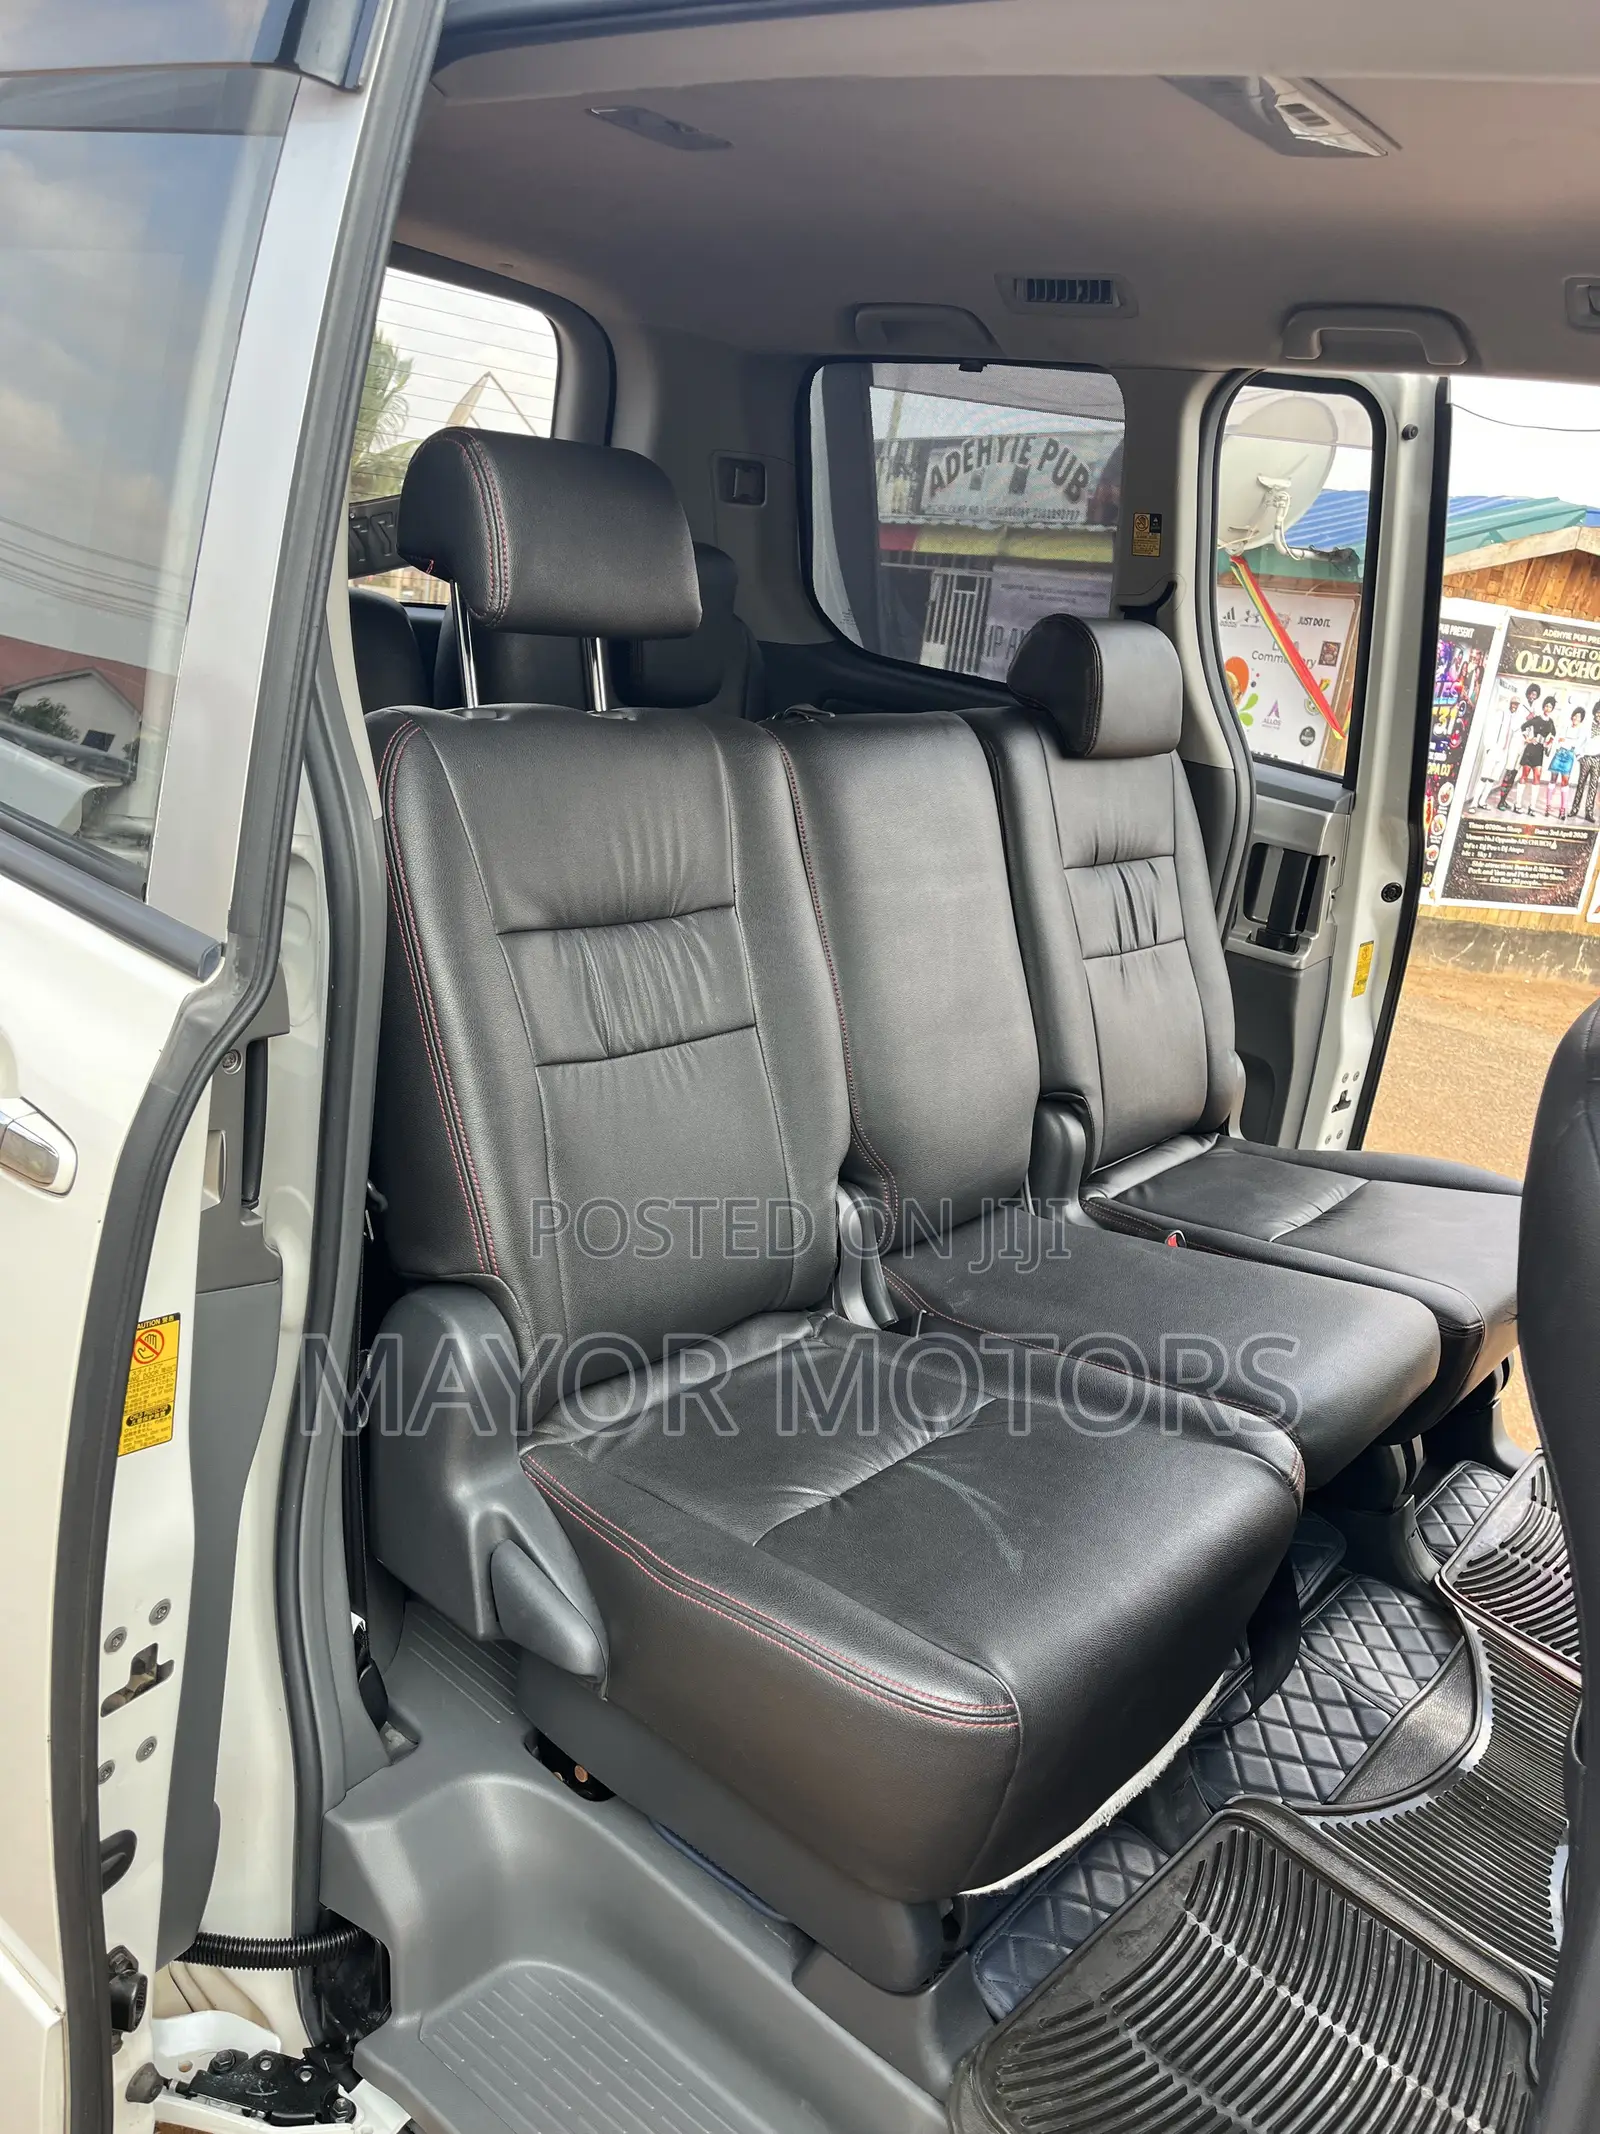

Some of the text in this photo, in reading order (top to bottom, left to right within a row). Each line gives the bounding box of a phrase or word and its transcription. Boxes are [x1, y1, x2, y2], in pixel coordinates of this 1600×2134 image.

[929, 434, 1090, 504] ADEHYIE PUB
[1297, 616, 1313, 626] JUST
[1313, 618, 1323, 627] DO
[1573, 632, 1587, 642] PUB
[1251, 650, 1317, 669] Commry
[1542, 643, 1551, 654] A
[1553, 644, 1589, 660] NIGHT
[1515, 649, 1555, 674] OLD
[136, 1318, 161, 1330] AUTION
